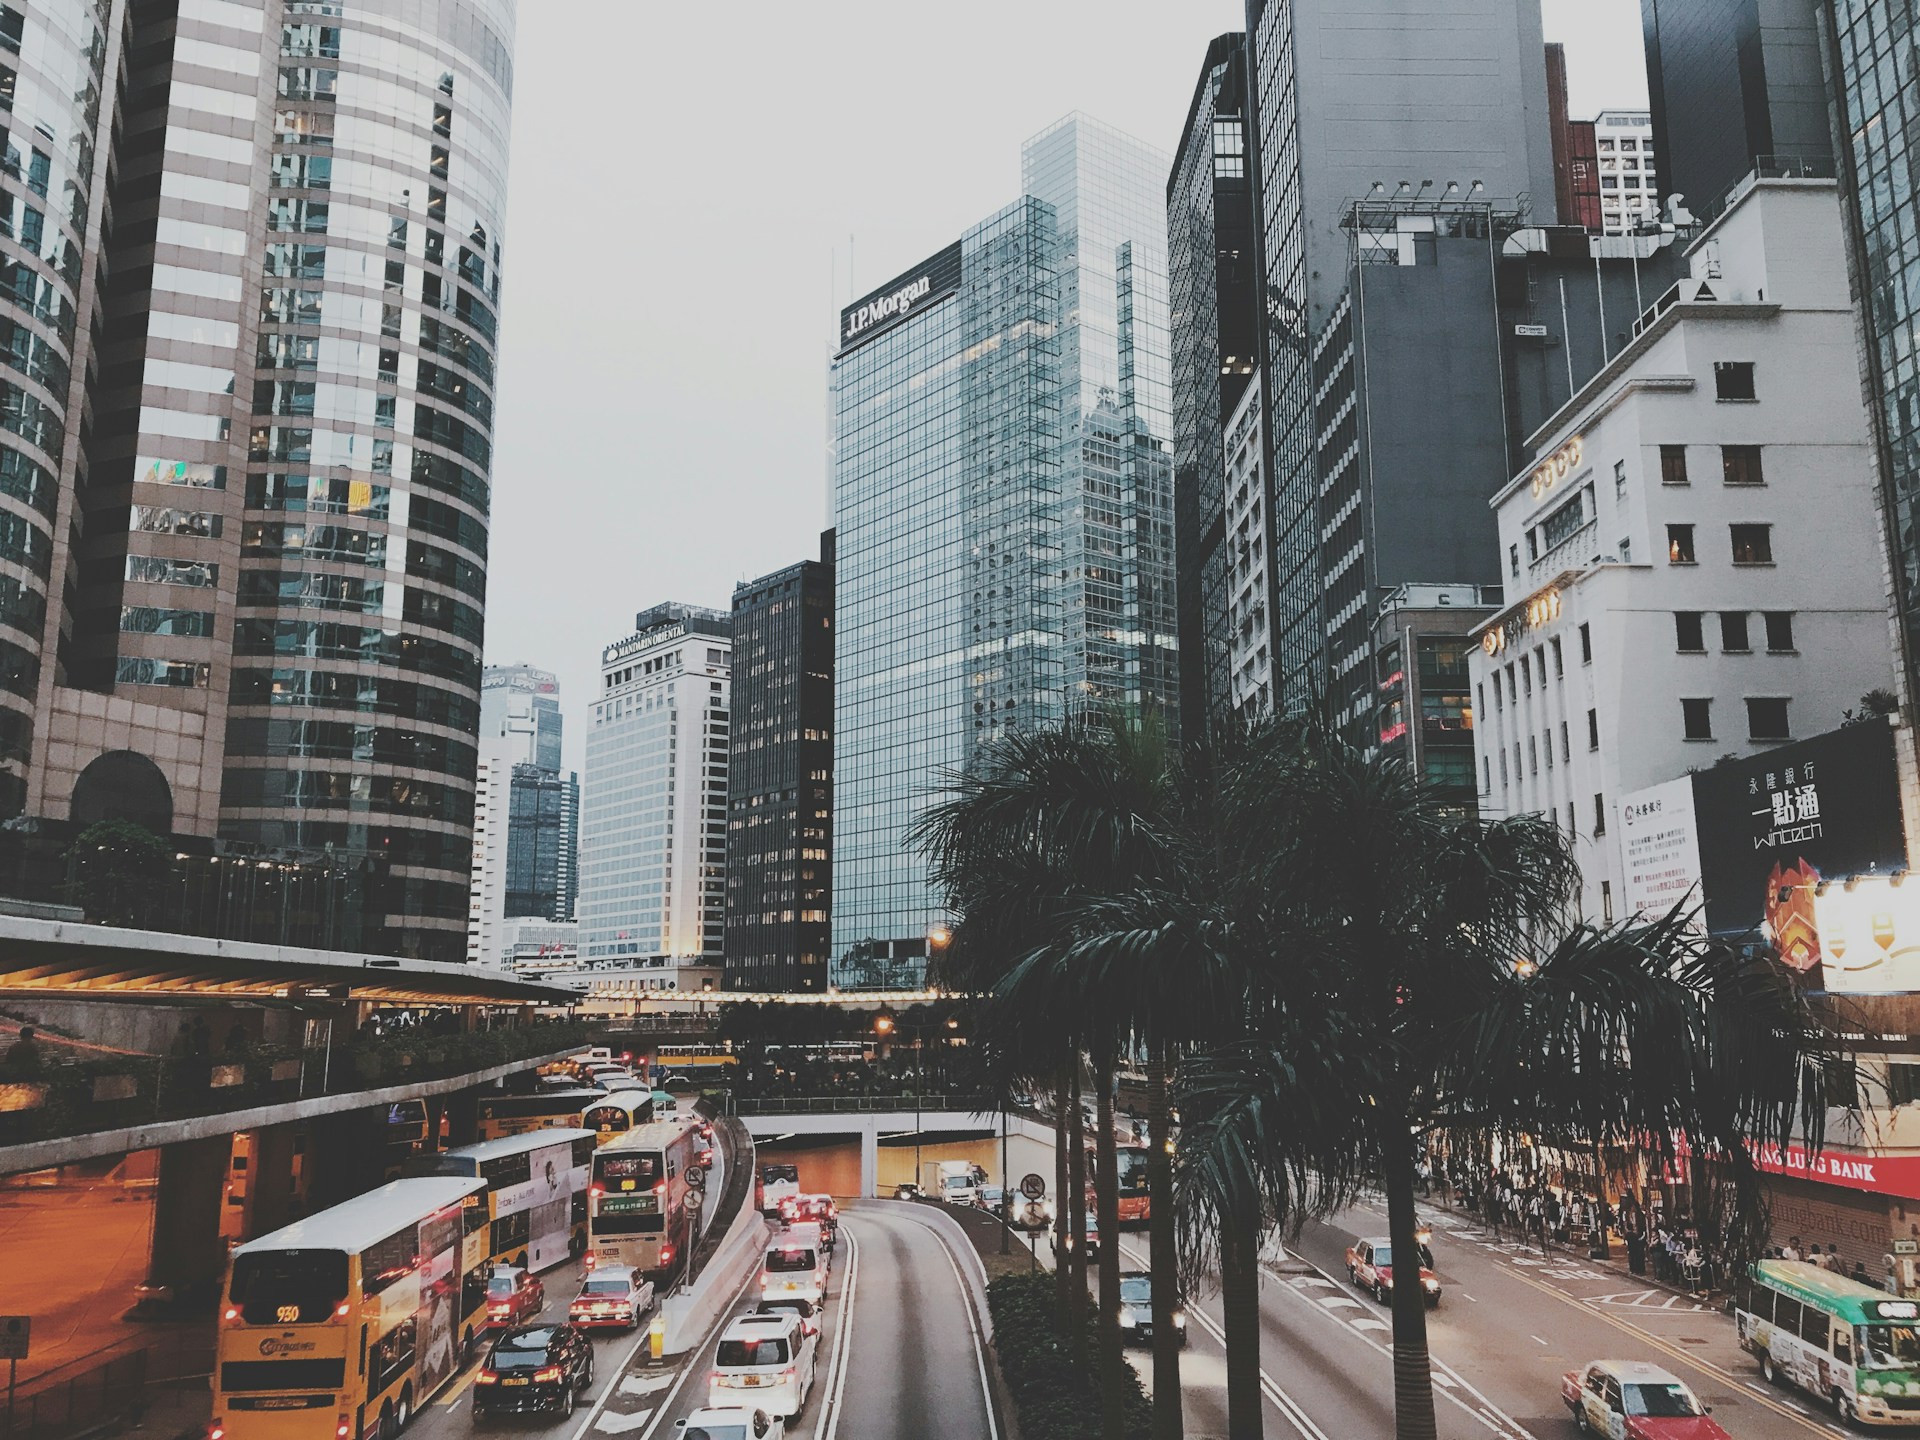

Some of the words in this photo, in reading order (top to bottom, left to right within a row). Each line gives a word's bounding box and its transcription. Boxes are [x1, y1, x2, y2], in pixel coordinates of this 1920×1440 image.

[618, 636, 653, 658] MANDARIN
[652, 624, 686, 646] ORIENTAL
[510, 677, 536, 691] LIPPO
[1751, 783, 1821, 827] 一點通
[1830, 1158, 1876, 1182] BANK
[1538, 1268, 1610, 1281] BUS
[277, 1306, 300, 1322] 930
